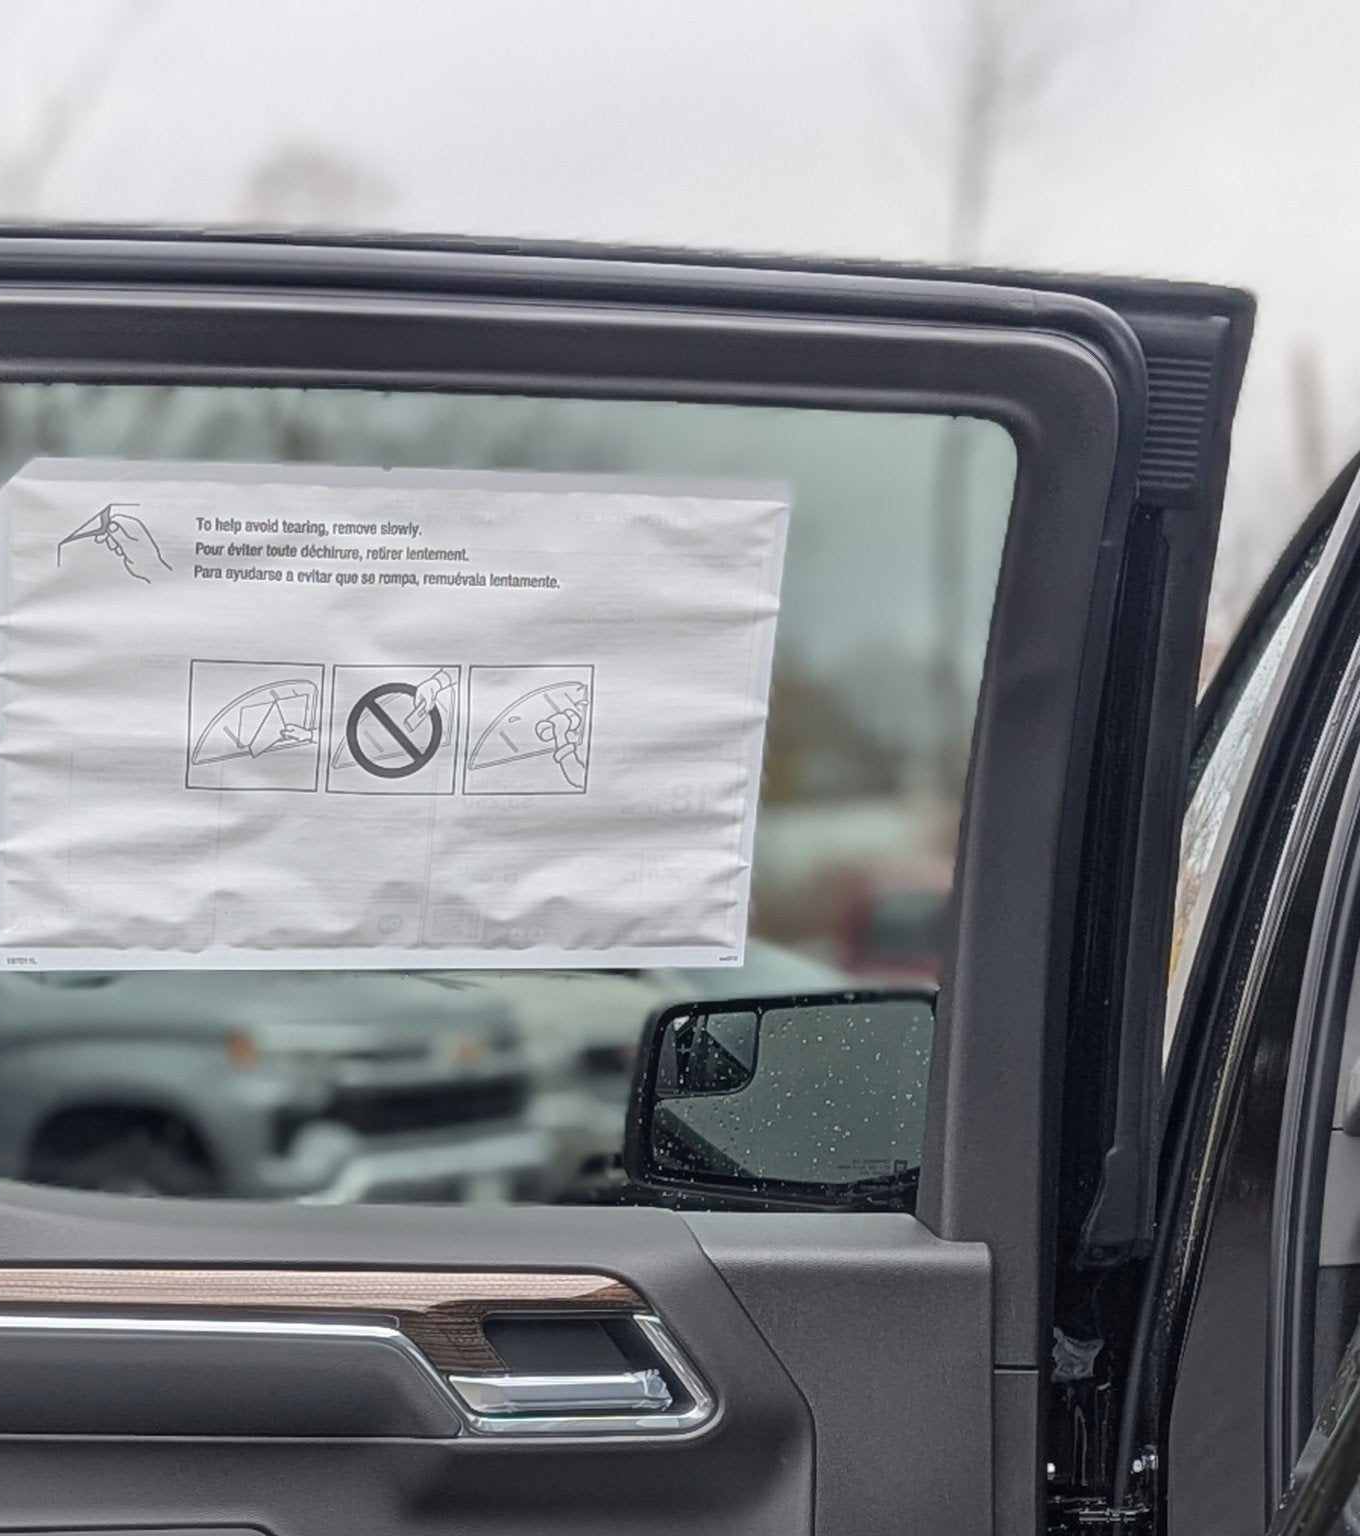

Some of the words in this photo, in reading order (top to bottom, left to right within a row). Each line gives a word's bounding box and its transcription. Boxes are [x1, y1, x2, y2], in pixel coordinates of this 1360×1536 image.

[196, 517, 211, 531] To
[215, 517, 242, 534] help
[245, 519, 278, 533] avoid
[282, 520, 329, 537] tearing,
[332, 522, 377, 535] remove
[381, 522, 422, 538] slowly.
[195, 542, 224, 556] Pour
[227, 542, 263, 557] éviter
[266, 544, 297, 557] toute
[301, 544, 363, 561] déchirure,
[366, 547, 404, 560] retirer
[406, 547, 469, 562] lentement.
[194, 565, 222, 579] Para
[226, 566, 282, 582] ayudarse
[286, 570, 294, 582] a
[297, 569, 333, 583] evitar
[336, 572, 358, 586] que
[361, 573, 375, 585] se
[379, 573, 419, 587] rompa,
[423, 571, 486, 587] remuévala
[489, 573, 561, 589] lentamente.
